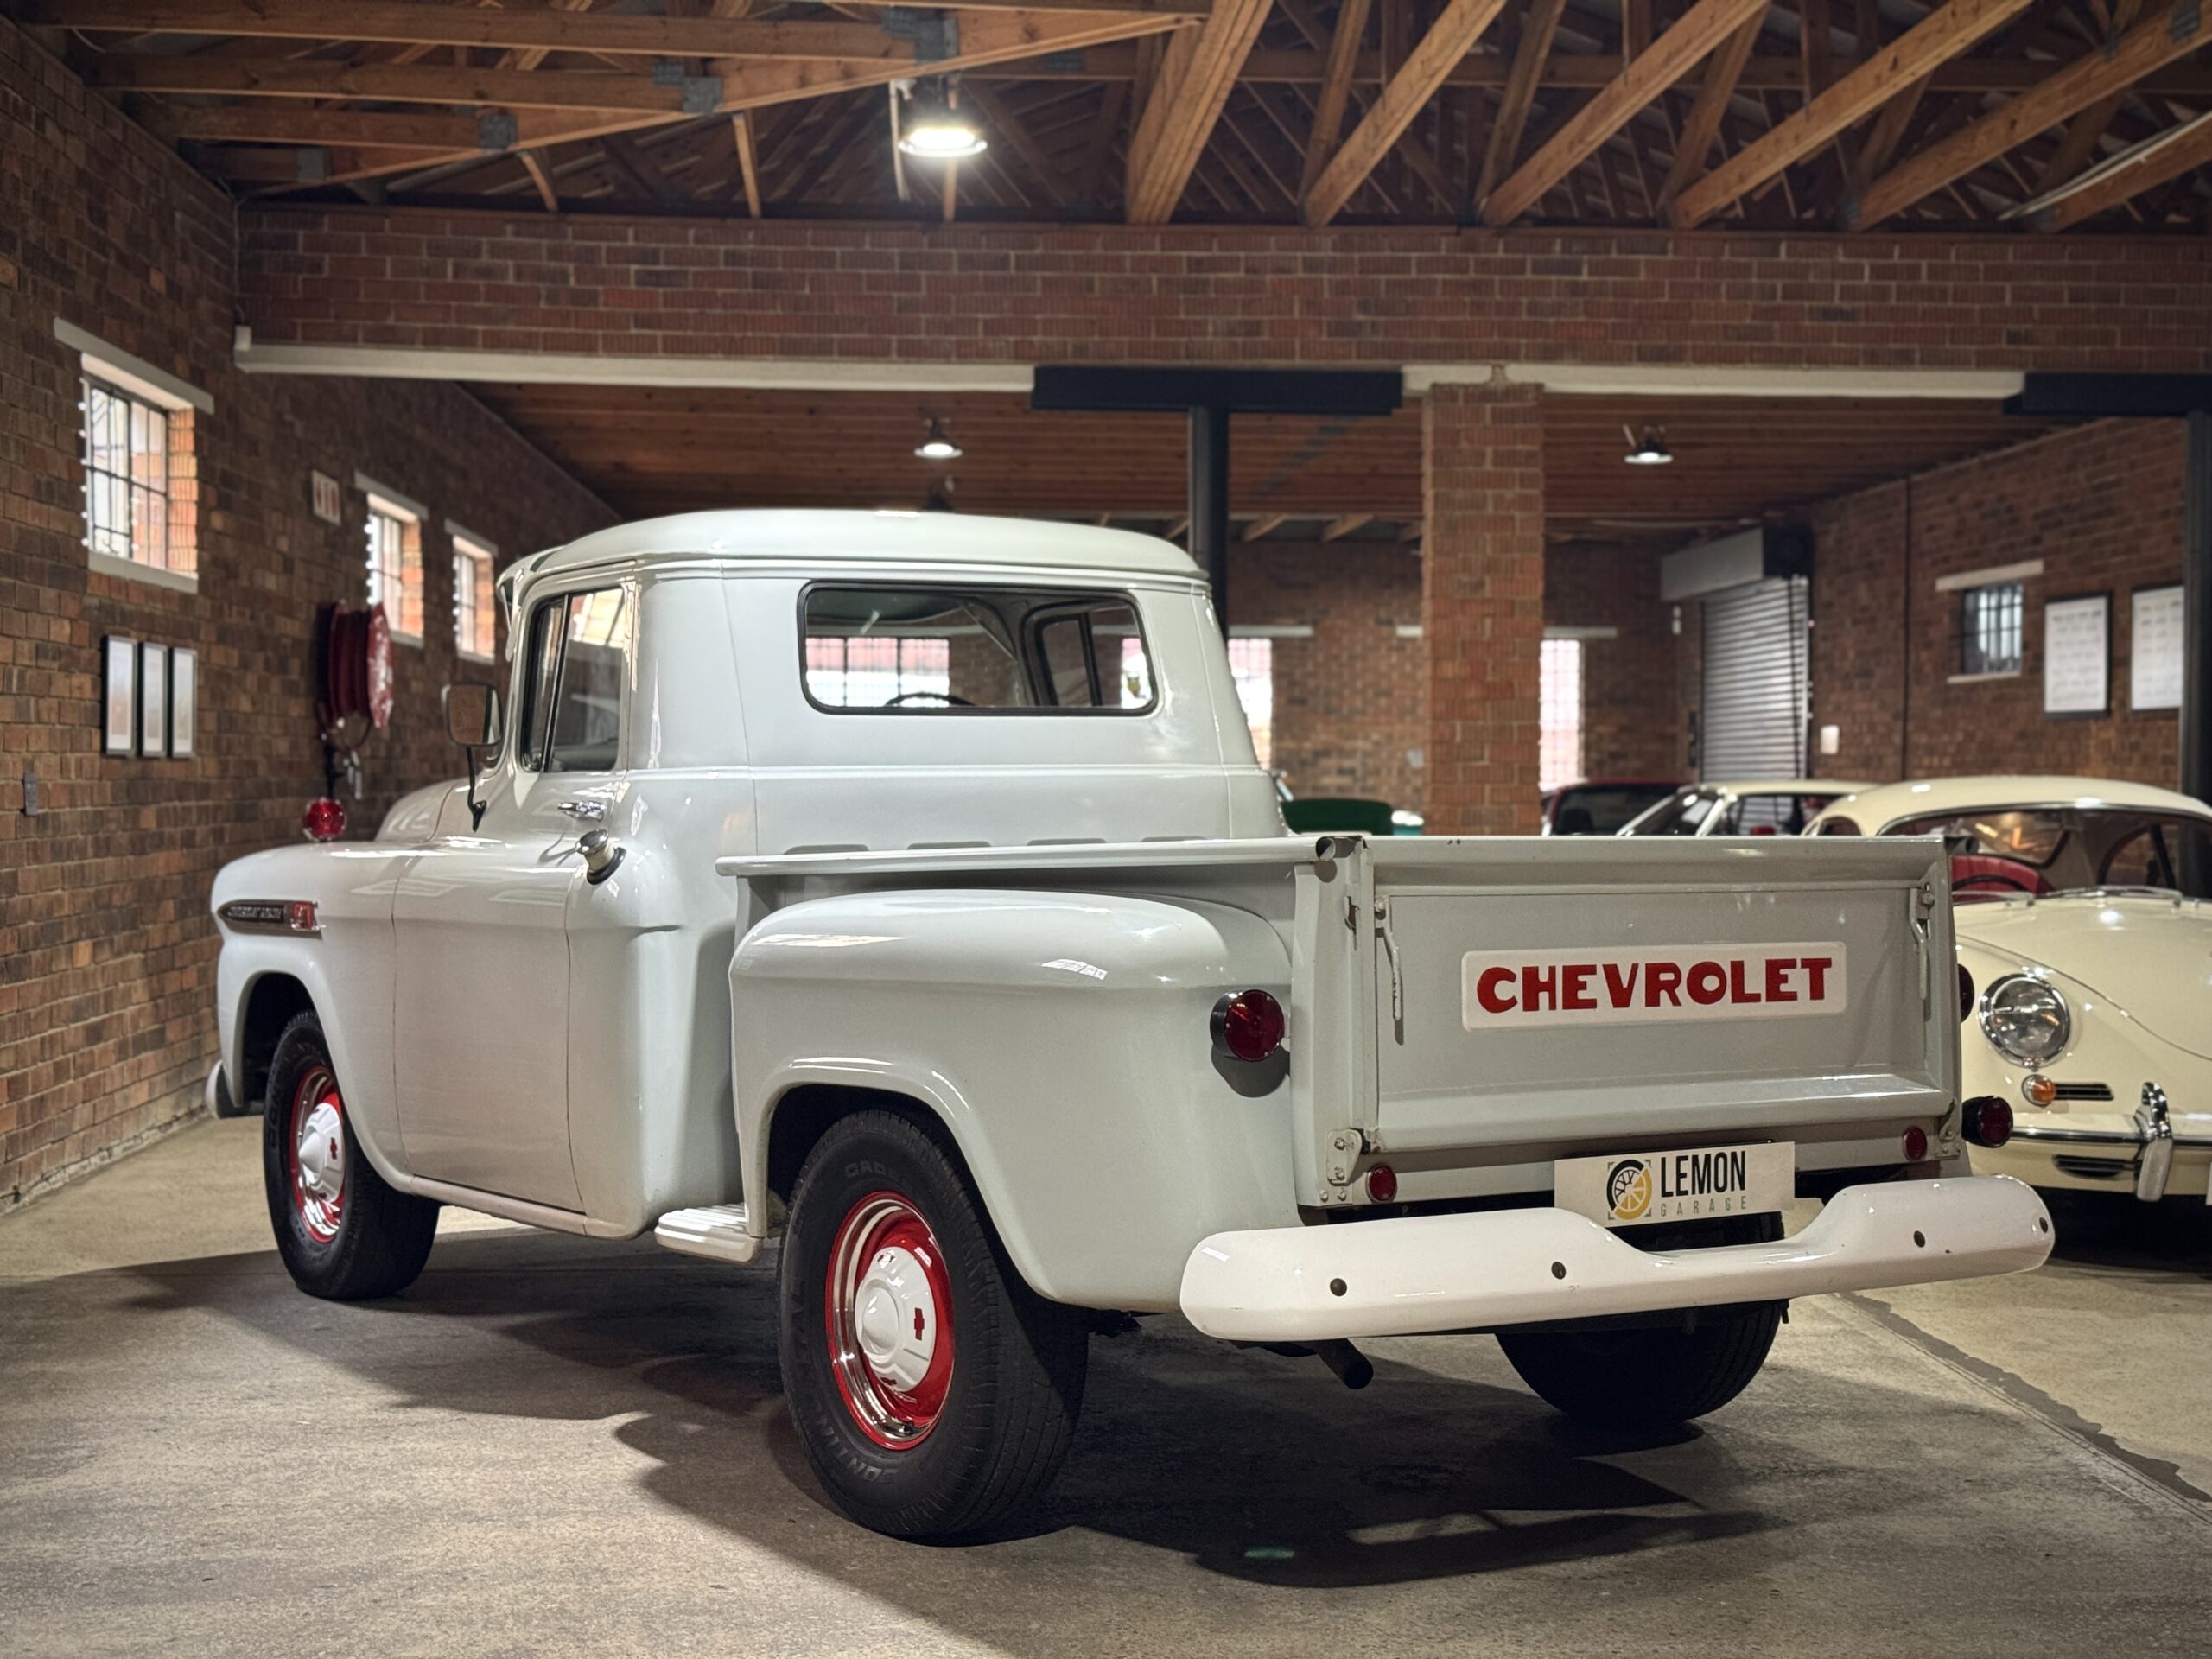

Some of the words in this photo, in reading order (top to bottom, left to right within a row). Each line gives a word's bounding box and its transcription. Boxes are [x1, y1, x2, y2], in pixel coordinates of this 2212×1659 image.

[1477, 958, 1832, 1013] CHEVROLET
[1661, 1151, 1745, 1198] LEMON
[1661, 1196, 1746, 1217] GARAGE
